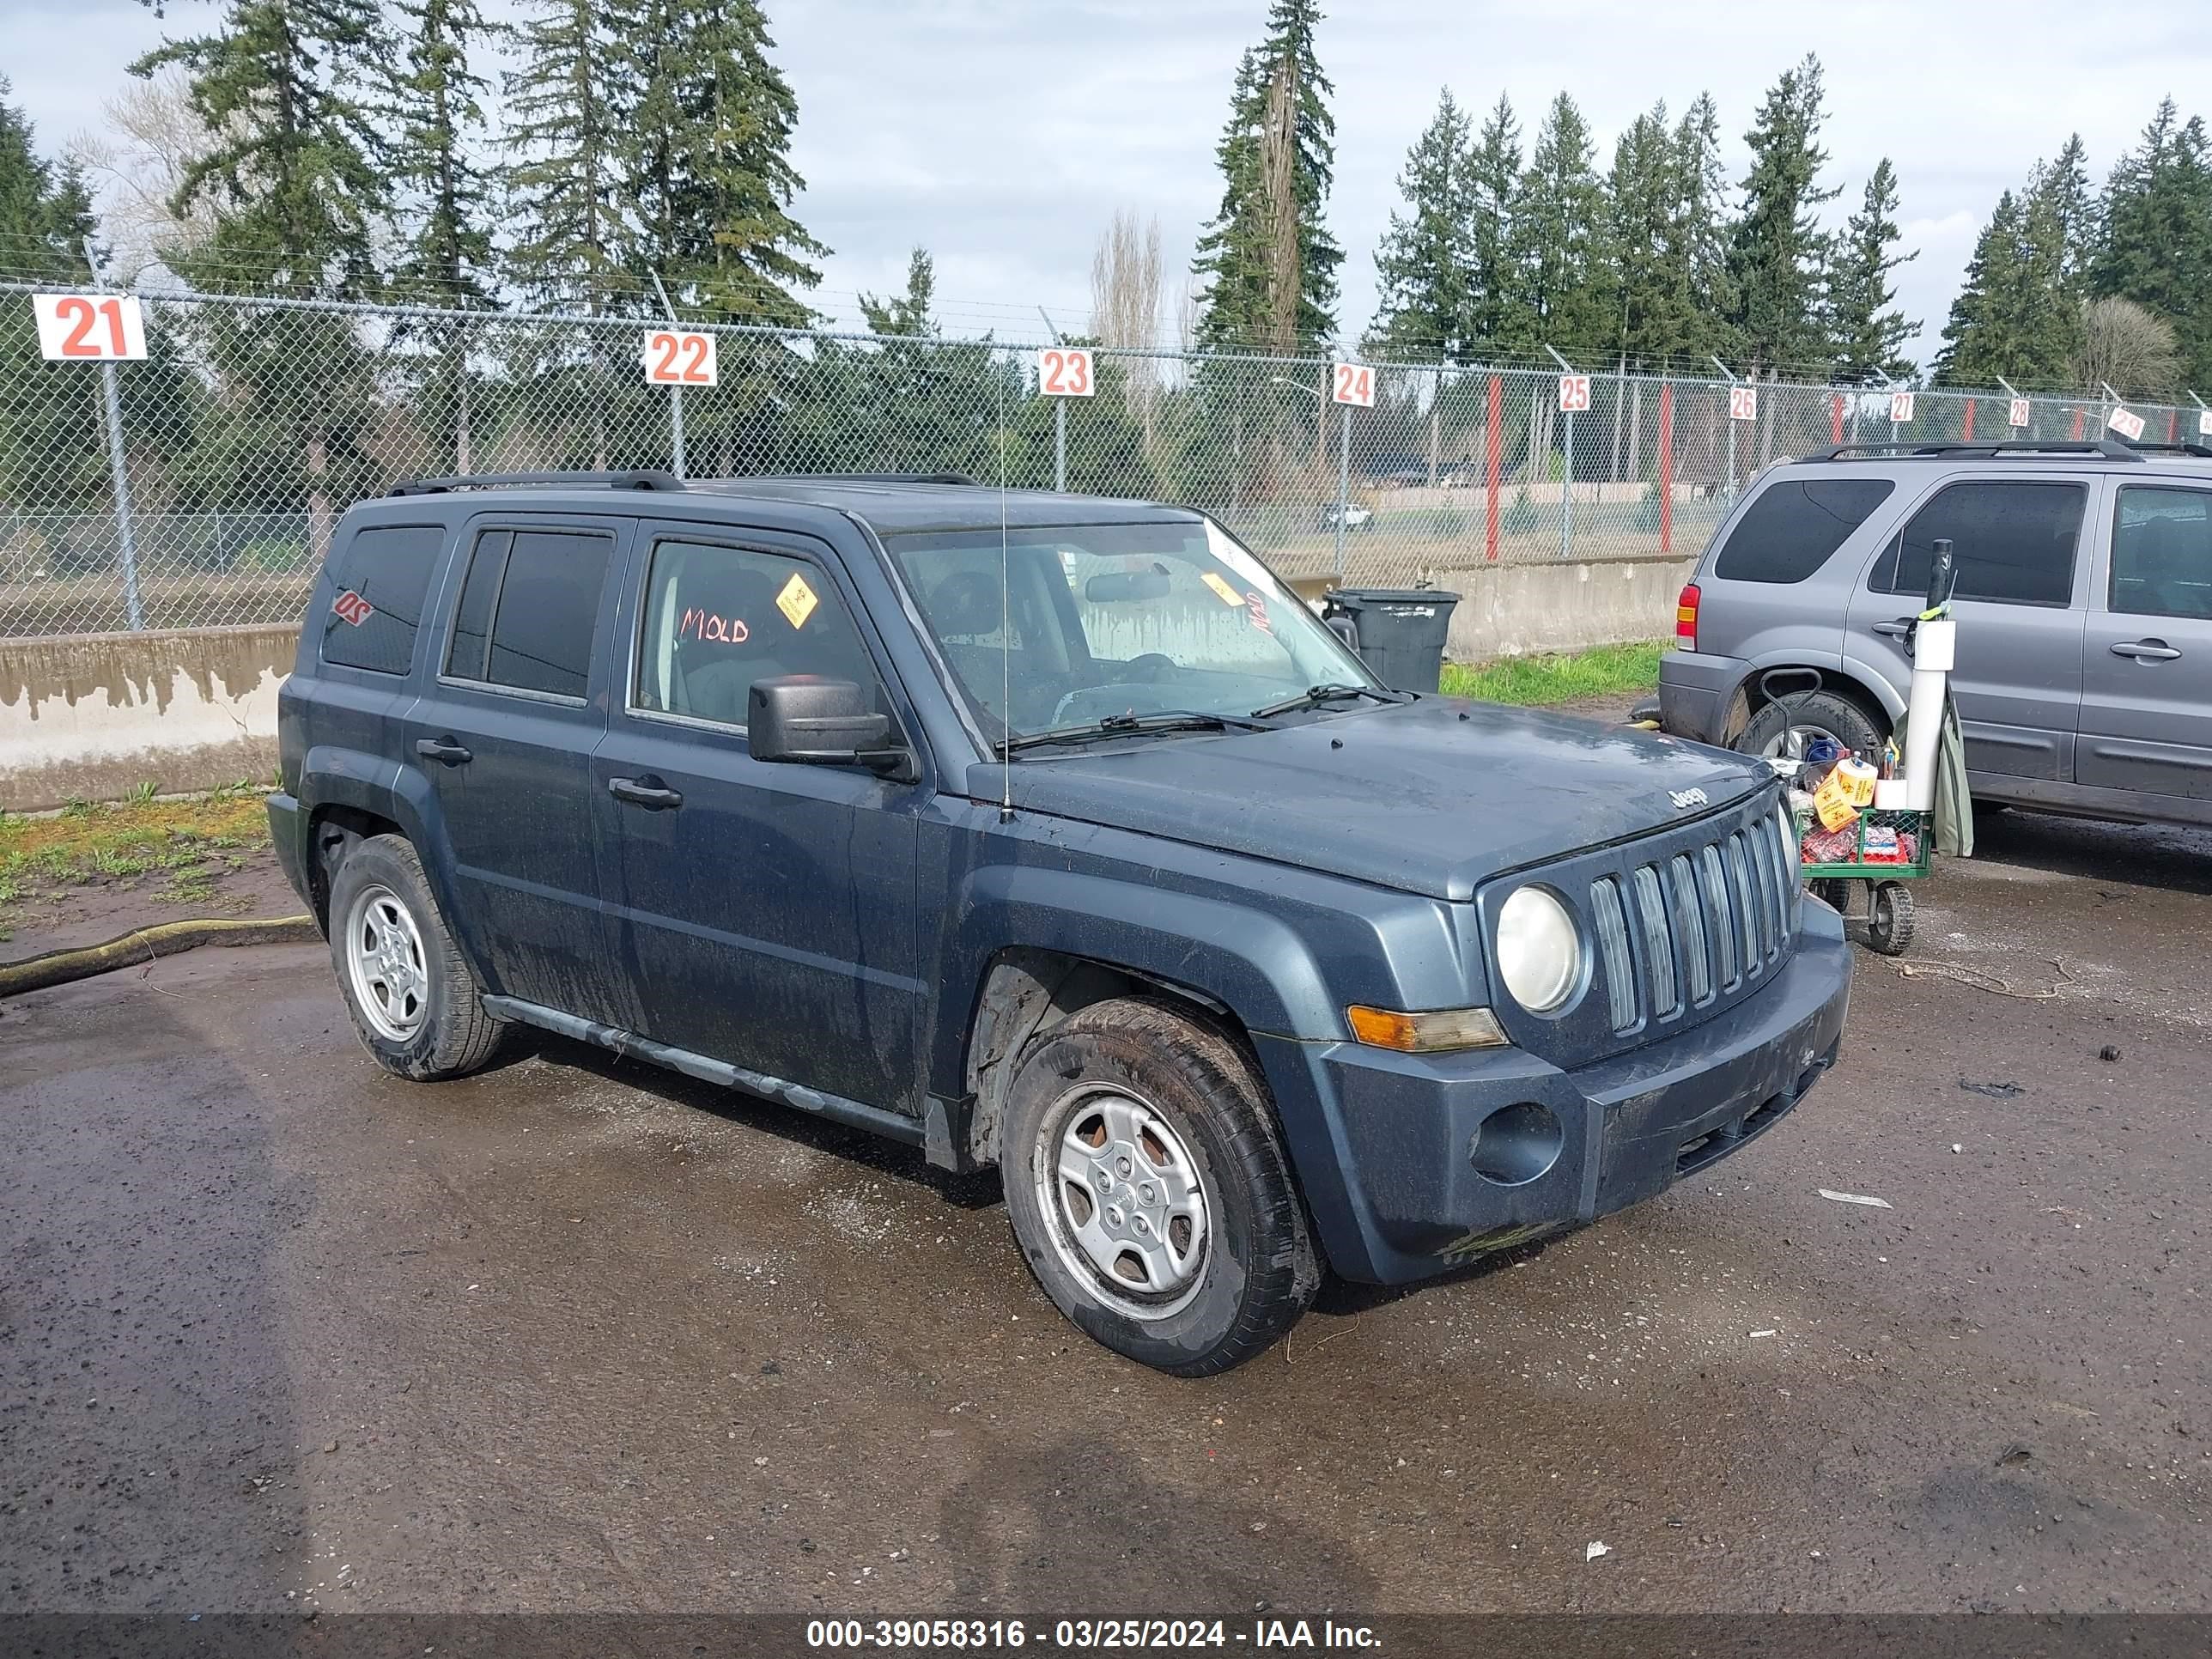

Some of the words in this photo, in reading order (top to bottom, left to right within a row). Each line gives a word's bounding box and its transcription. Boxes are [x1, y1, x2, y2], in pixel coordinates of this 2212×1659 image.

[56, 297, 127, 356] 21
[653, 334, 709, 382] 22
[1043, 351, 1087, 393] 23
[1337, 366, 1370, 404] 24
[1562, 378, 1588, 410] 25
[1732, 390, 1754, 418] 26
[1893, 394, 1911, 420] 27
[2011, 402, 2027, 424] 28
[2112, 411, 2141, 436] 29
[680, 605, 750, 643] MOLD
[1667, 787, 1709, 808] Jeep
